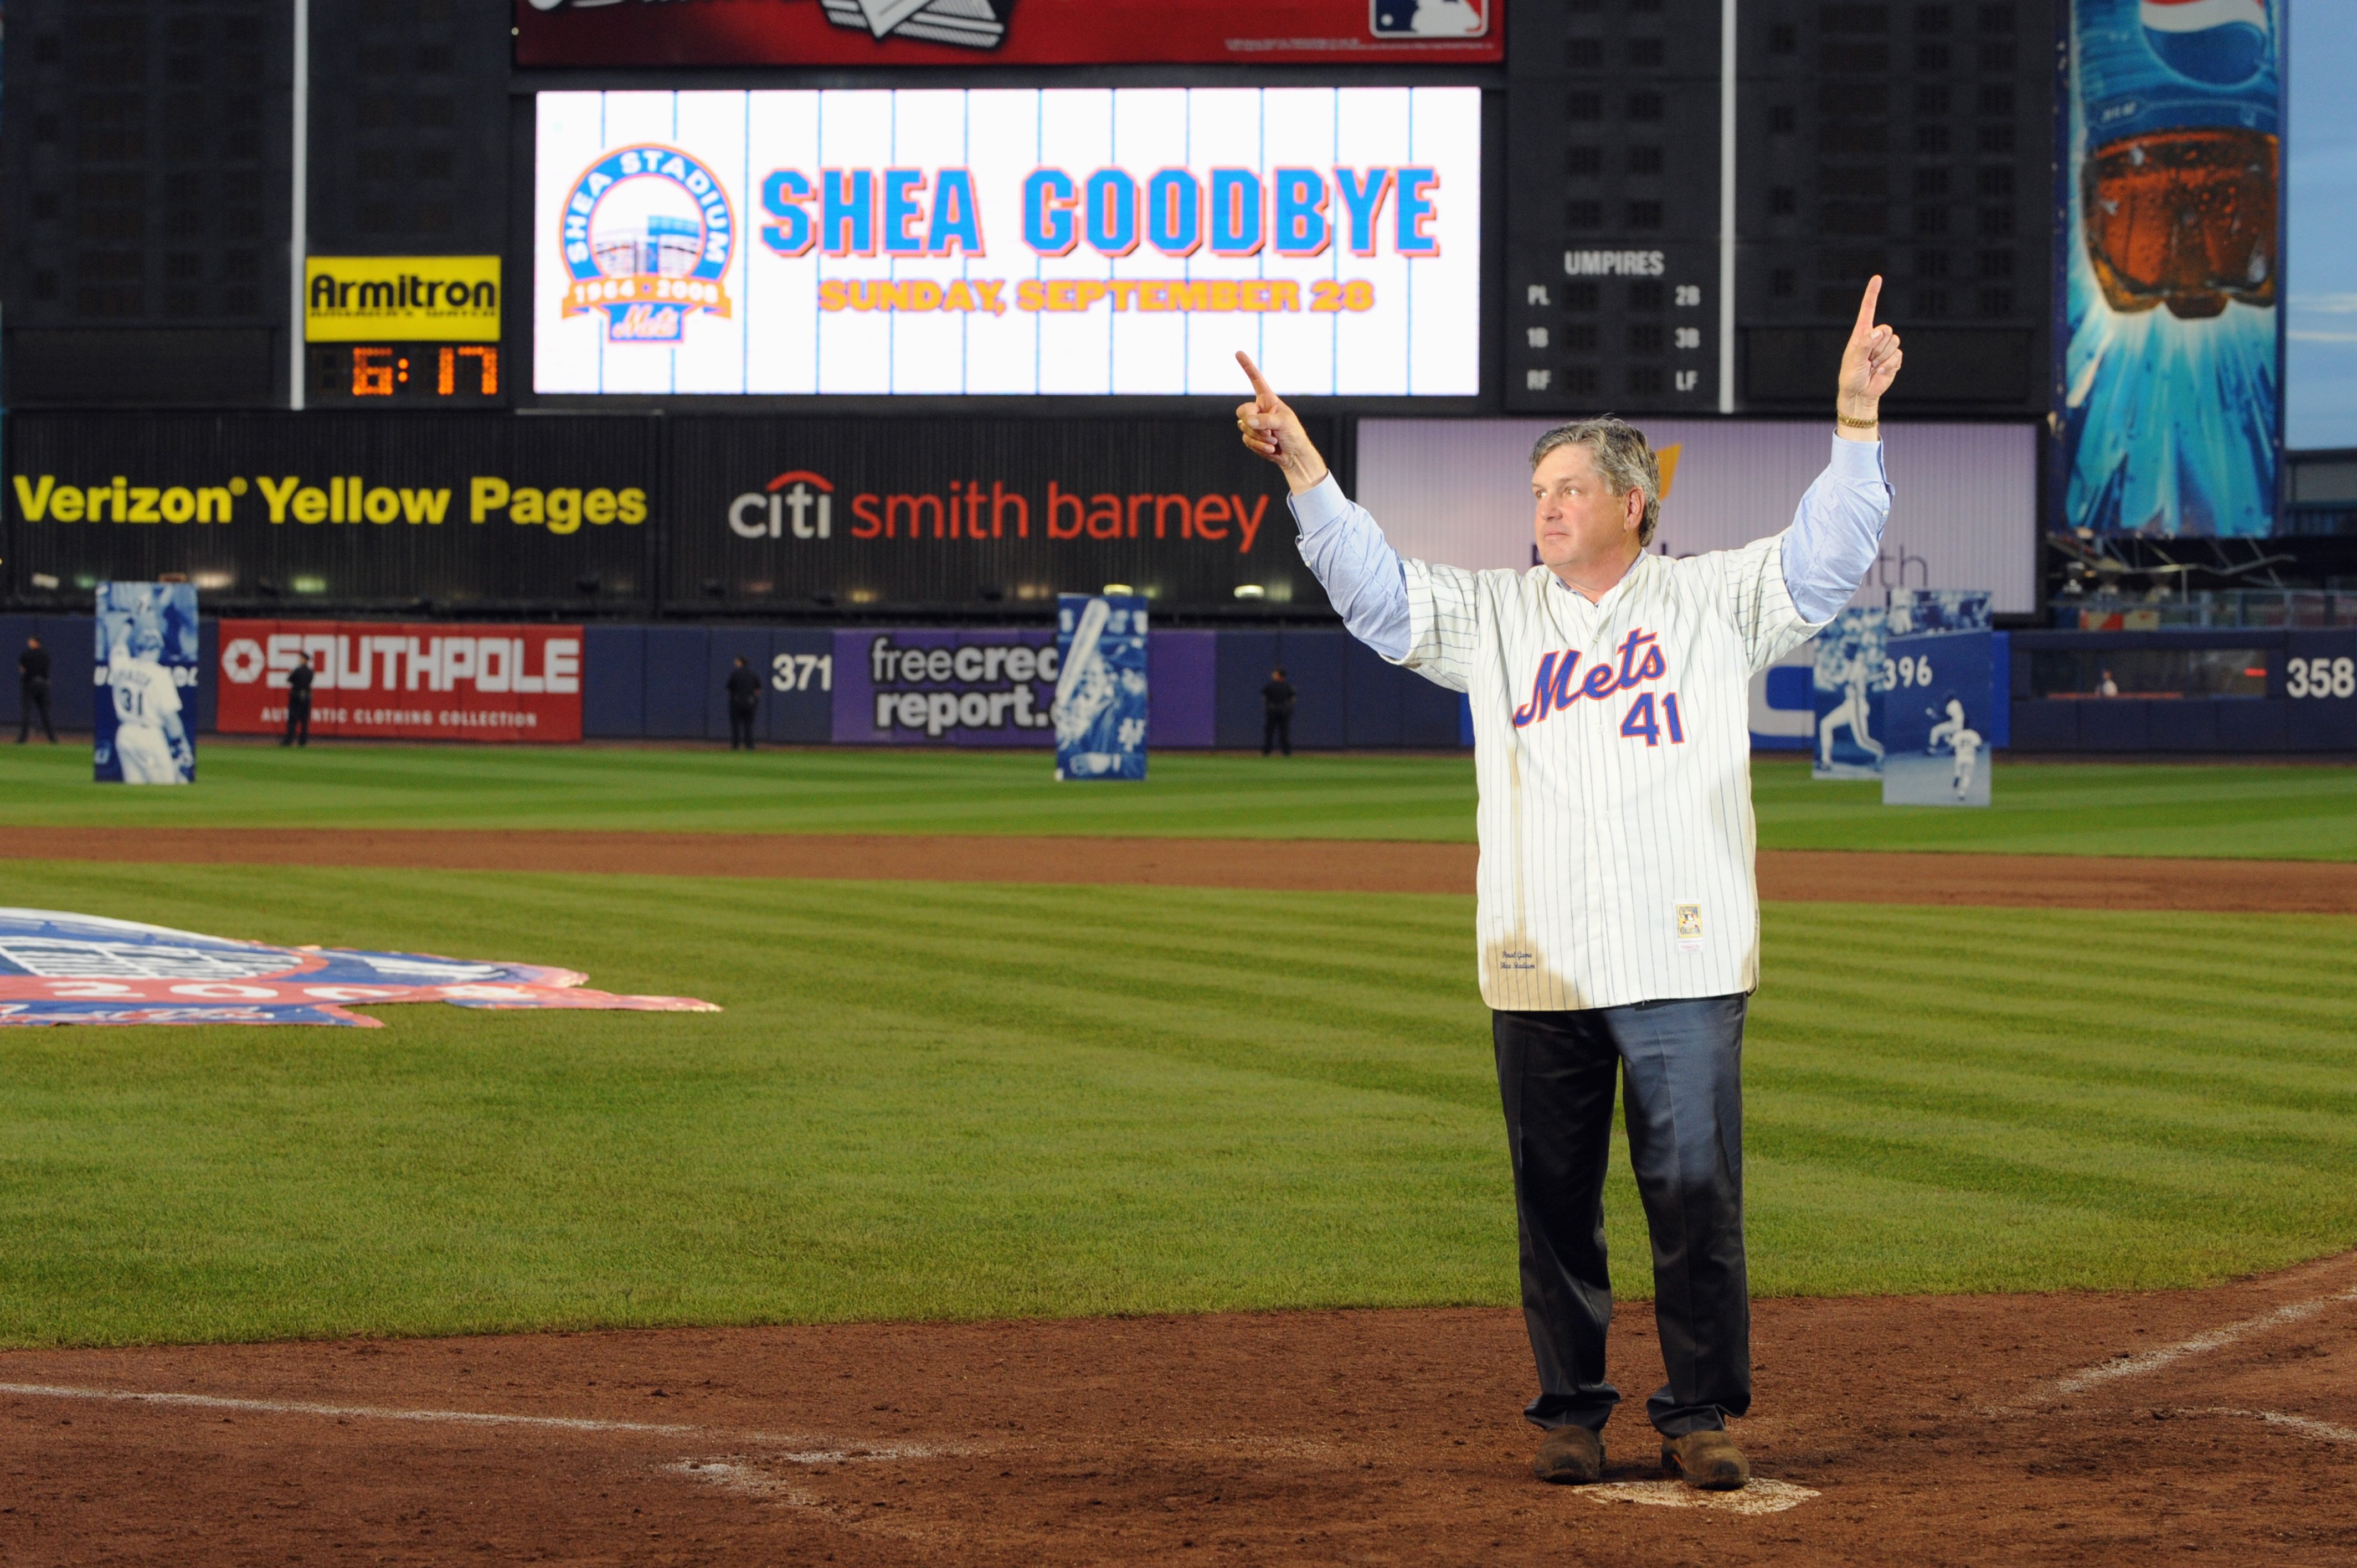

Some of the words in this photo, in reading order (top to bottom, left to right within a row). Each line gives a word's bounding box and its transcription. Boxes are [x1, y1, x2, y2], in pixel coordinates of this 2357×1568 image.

[567, 173, 613, 264] SHEA
[620, 150, 728, 264] STADIUM
[760, 168, 985, 257] SHEA
[1021, 167, 1440, 257] GOODBYE
[1565, 250, 1664, 275] UMPIRES
[311, 275, 496, 308] Armitron
[656, 280, 719, 304] 2008
[817, 278, 1006, 316] SUNDAY,
[1015, 278, 1301, 312] SEPTEMBER
[1309, 278, 1375, 312] 28
[1675, 285, 1700, 306] 2B
[353, 347, 497, 395] 6:17
[1527, 370, 1551, 390] RF
[1676, 370, 1697, 391] LF
[256, 477, 450, 524] Yellow
[471, 477, 647, 534] Pages
[728, 483, 832, 539] citi
[851, 481, 1028, 539] smith
[1047, 481, 1269, 554] barney
[267, 634, 579, 694] SOUTHPOLE
[772, 653, 832, 691] 371
[1512, 627, 1666, 728] Mets
[1883, 654, 1933, 691] 396
[2286, 657, 2355, 699] 358
[877, 684, 1056, 736] report.
[1620, 692, 1685, 746] 41
